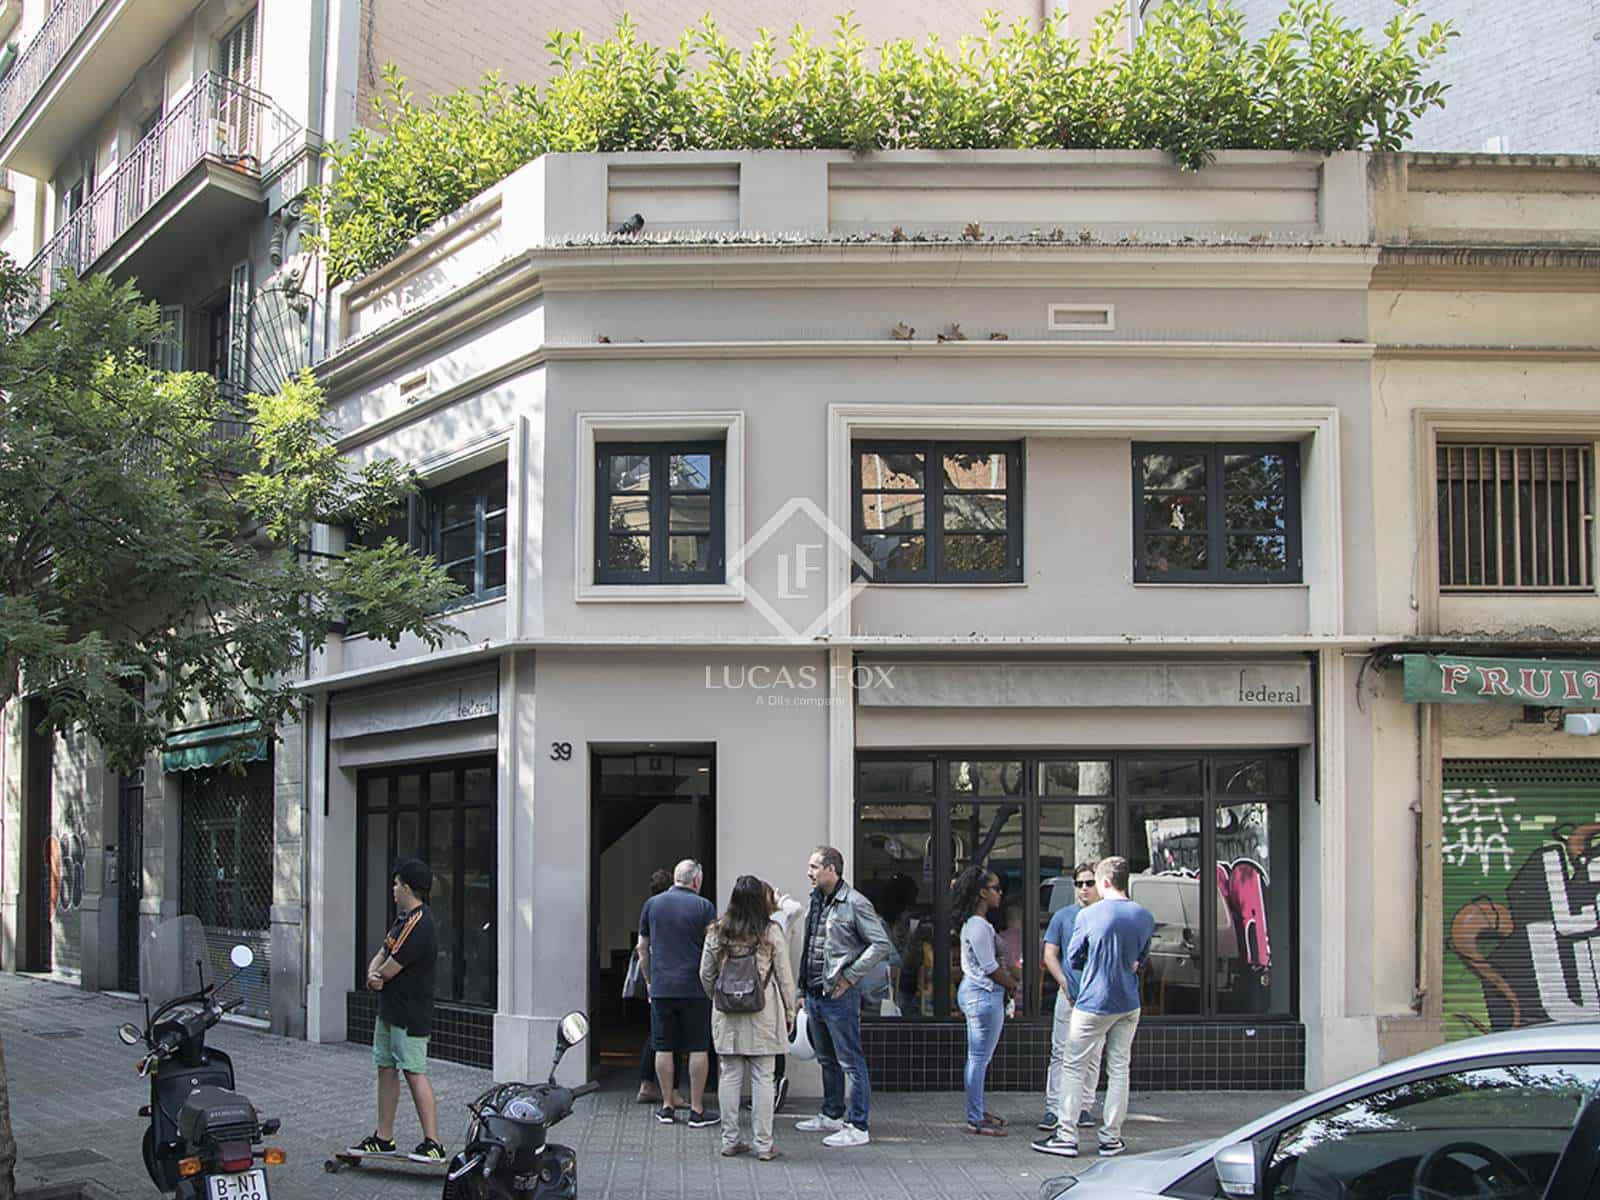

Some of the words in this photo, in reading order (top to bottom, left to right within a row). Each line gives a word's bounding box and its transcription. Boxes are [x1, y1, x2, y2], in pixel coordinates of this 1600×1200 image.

[1239, 669, 1301, 703] federal
[550, 742, 573, 761] 39
[216, 1173, 257, 1196] B-NT
